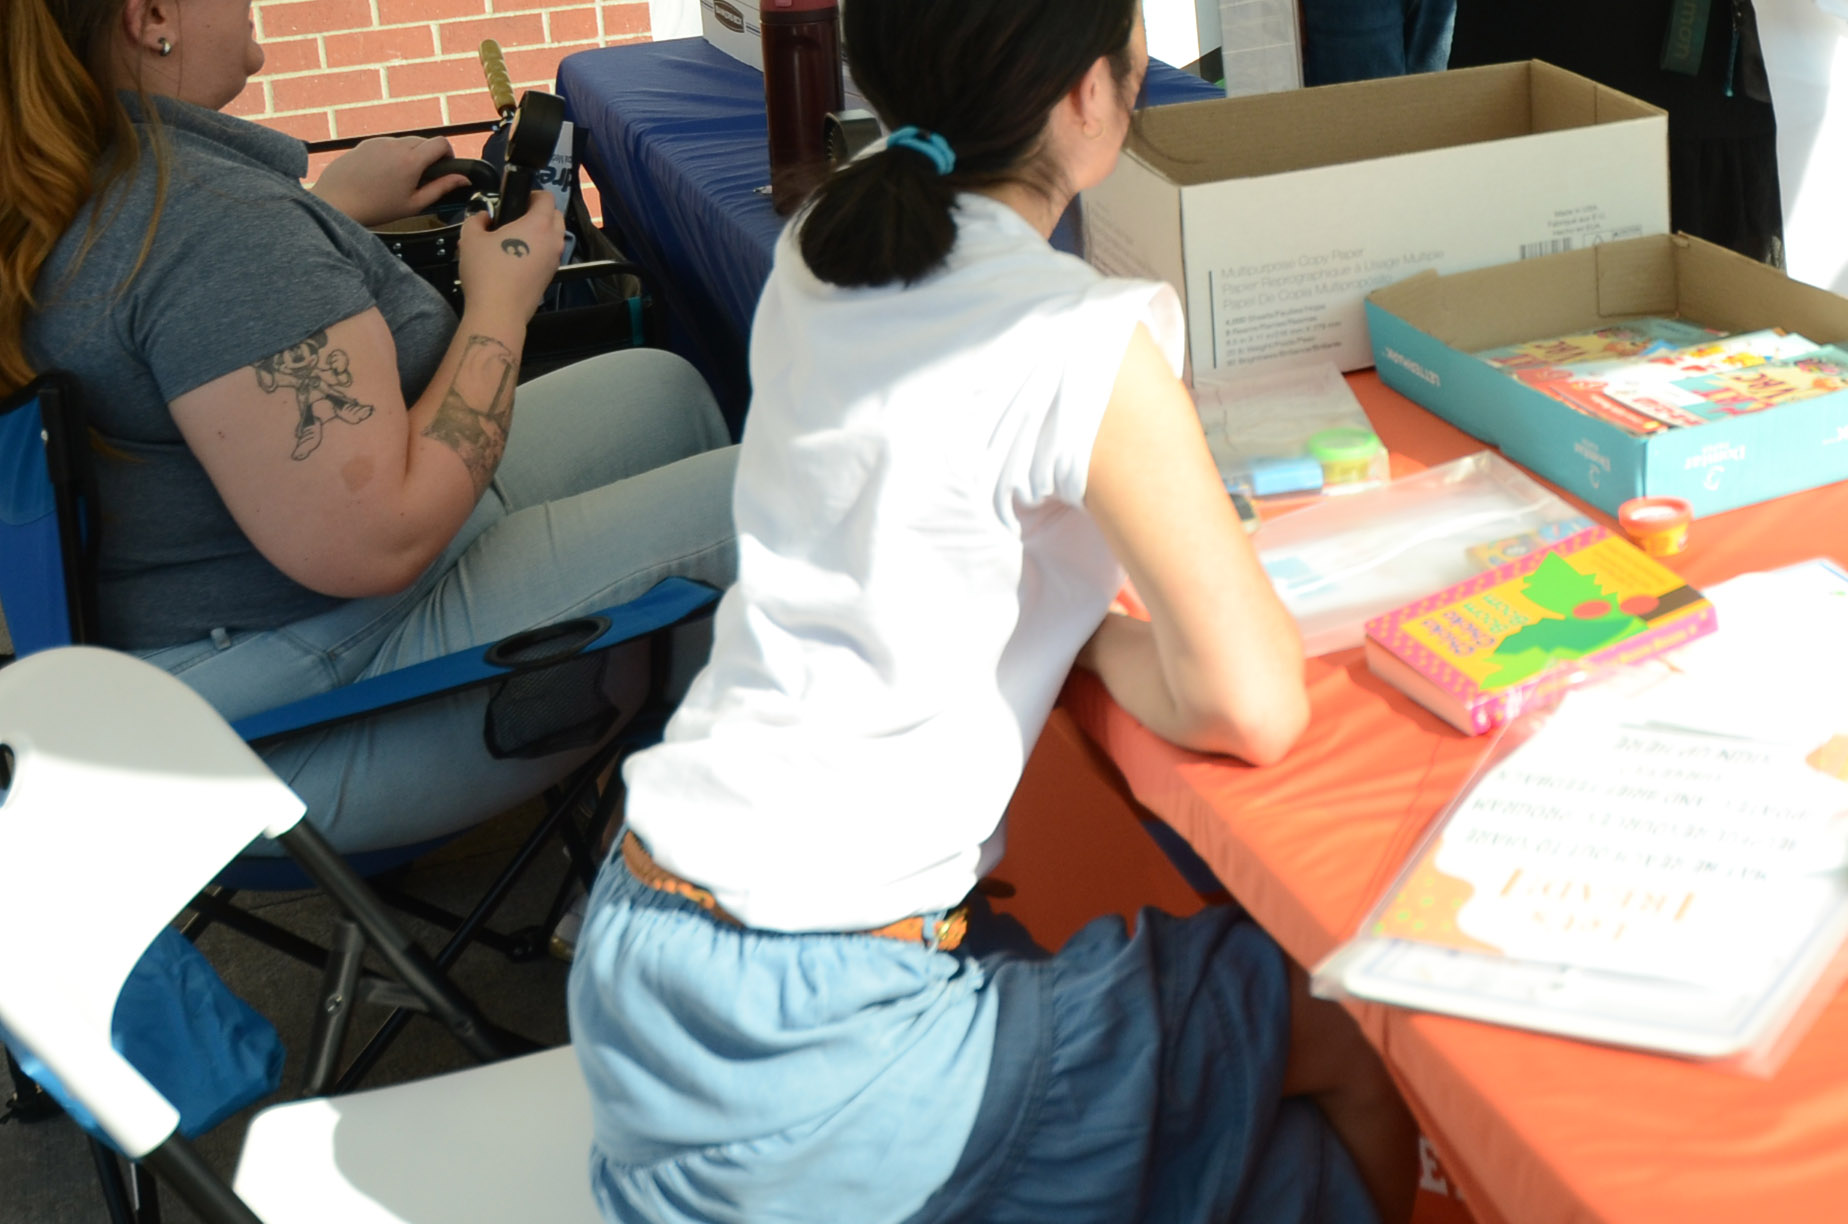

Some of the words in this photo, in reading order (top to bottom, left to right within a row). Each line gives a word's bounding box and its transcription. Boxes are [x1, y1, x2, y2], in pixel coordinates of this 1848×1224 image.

[1221, 258, 1297, 279] Multipurpose
[1300, 252, 1329, 266] Copy
[1331, 247, 1365, 260] Paper
